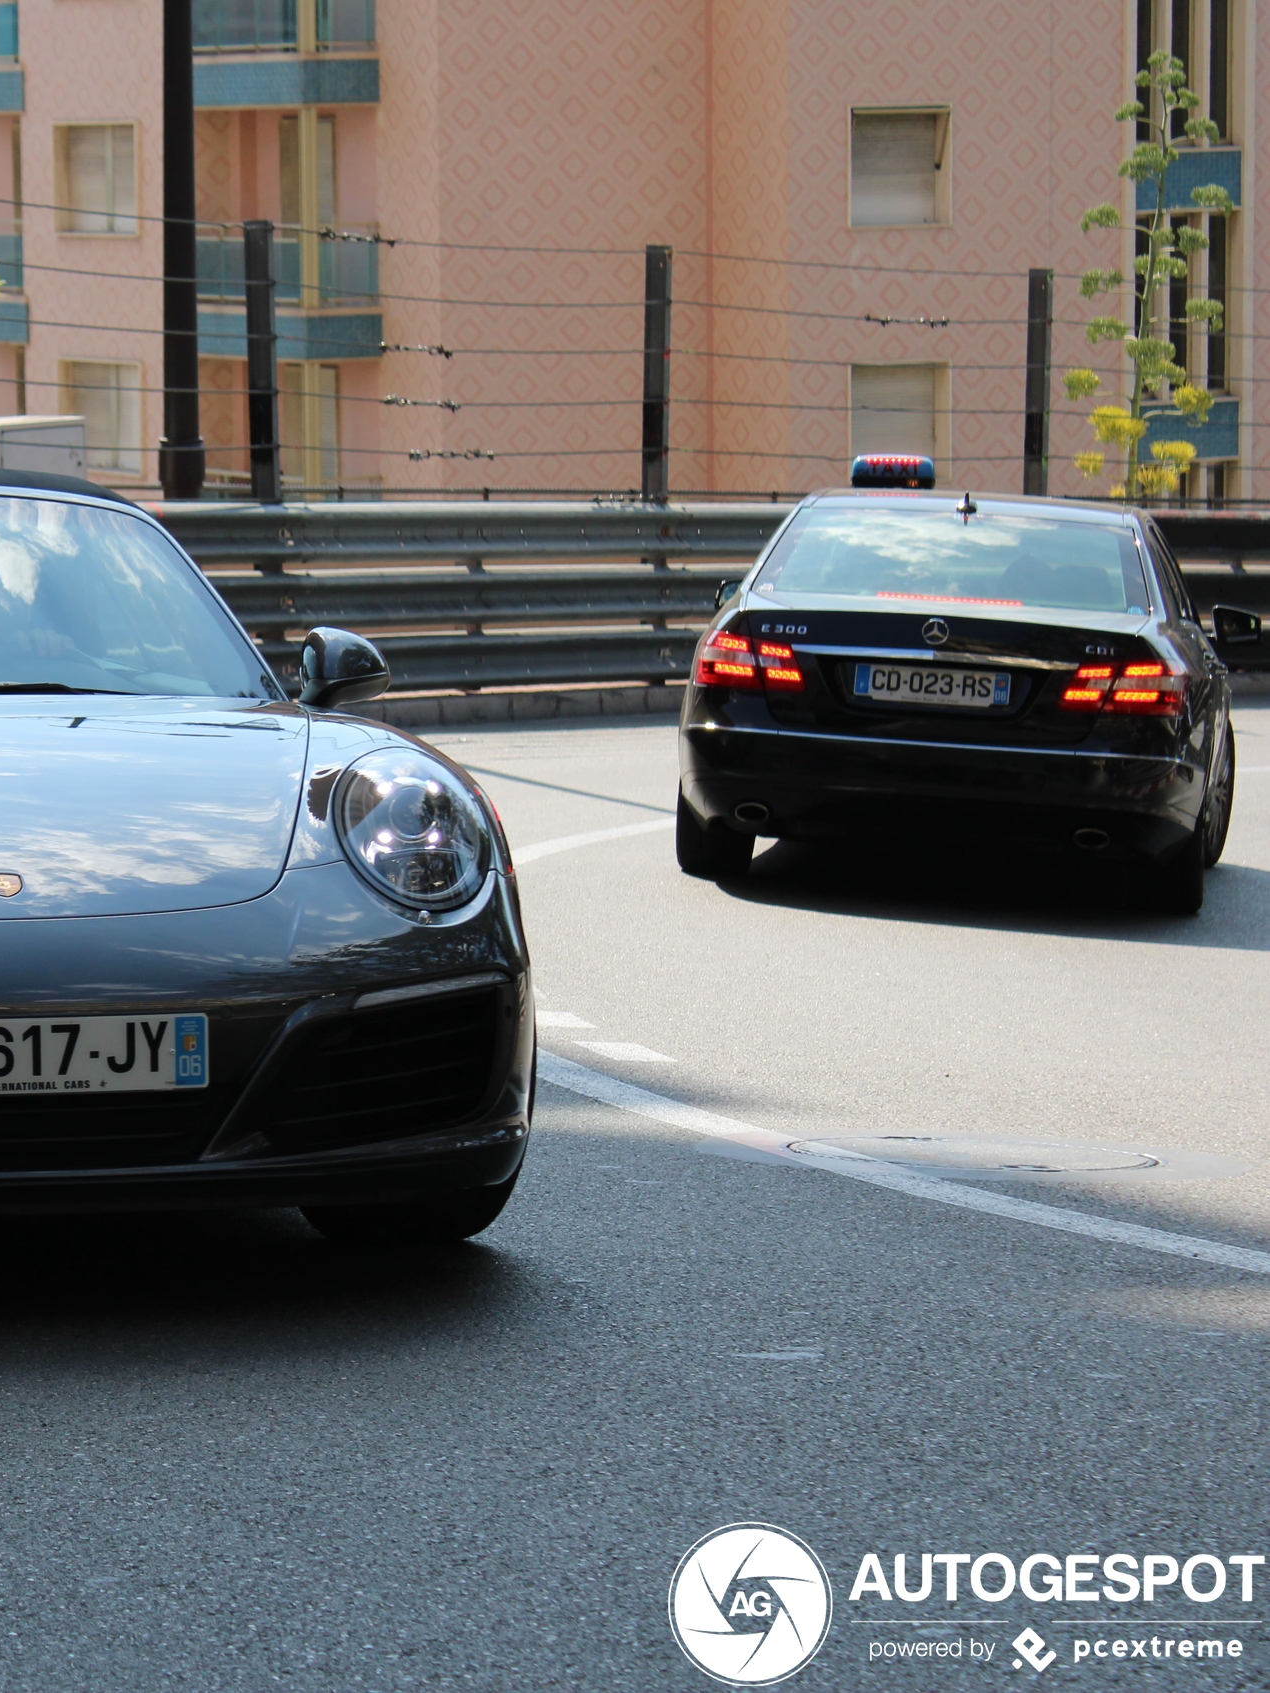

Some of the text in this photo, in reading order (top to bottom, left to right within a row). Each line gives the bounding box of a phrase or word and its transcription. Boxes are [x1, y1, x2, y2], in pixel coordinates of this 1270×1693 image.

[869, 461, 918, 476] TAXI
[761, 623, 808, 635] E 300
[1085, 644, 1115, 656] CDI
[871, 669, 993, 698] CD-023-RS
[179, 1055, 201, 1076] 06
[64, 1080, 91, 1090] CARS
